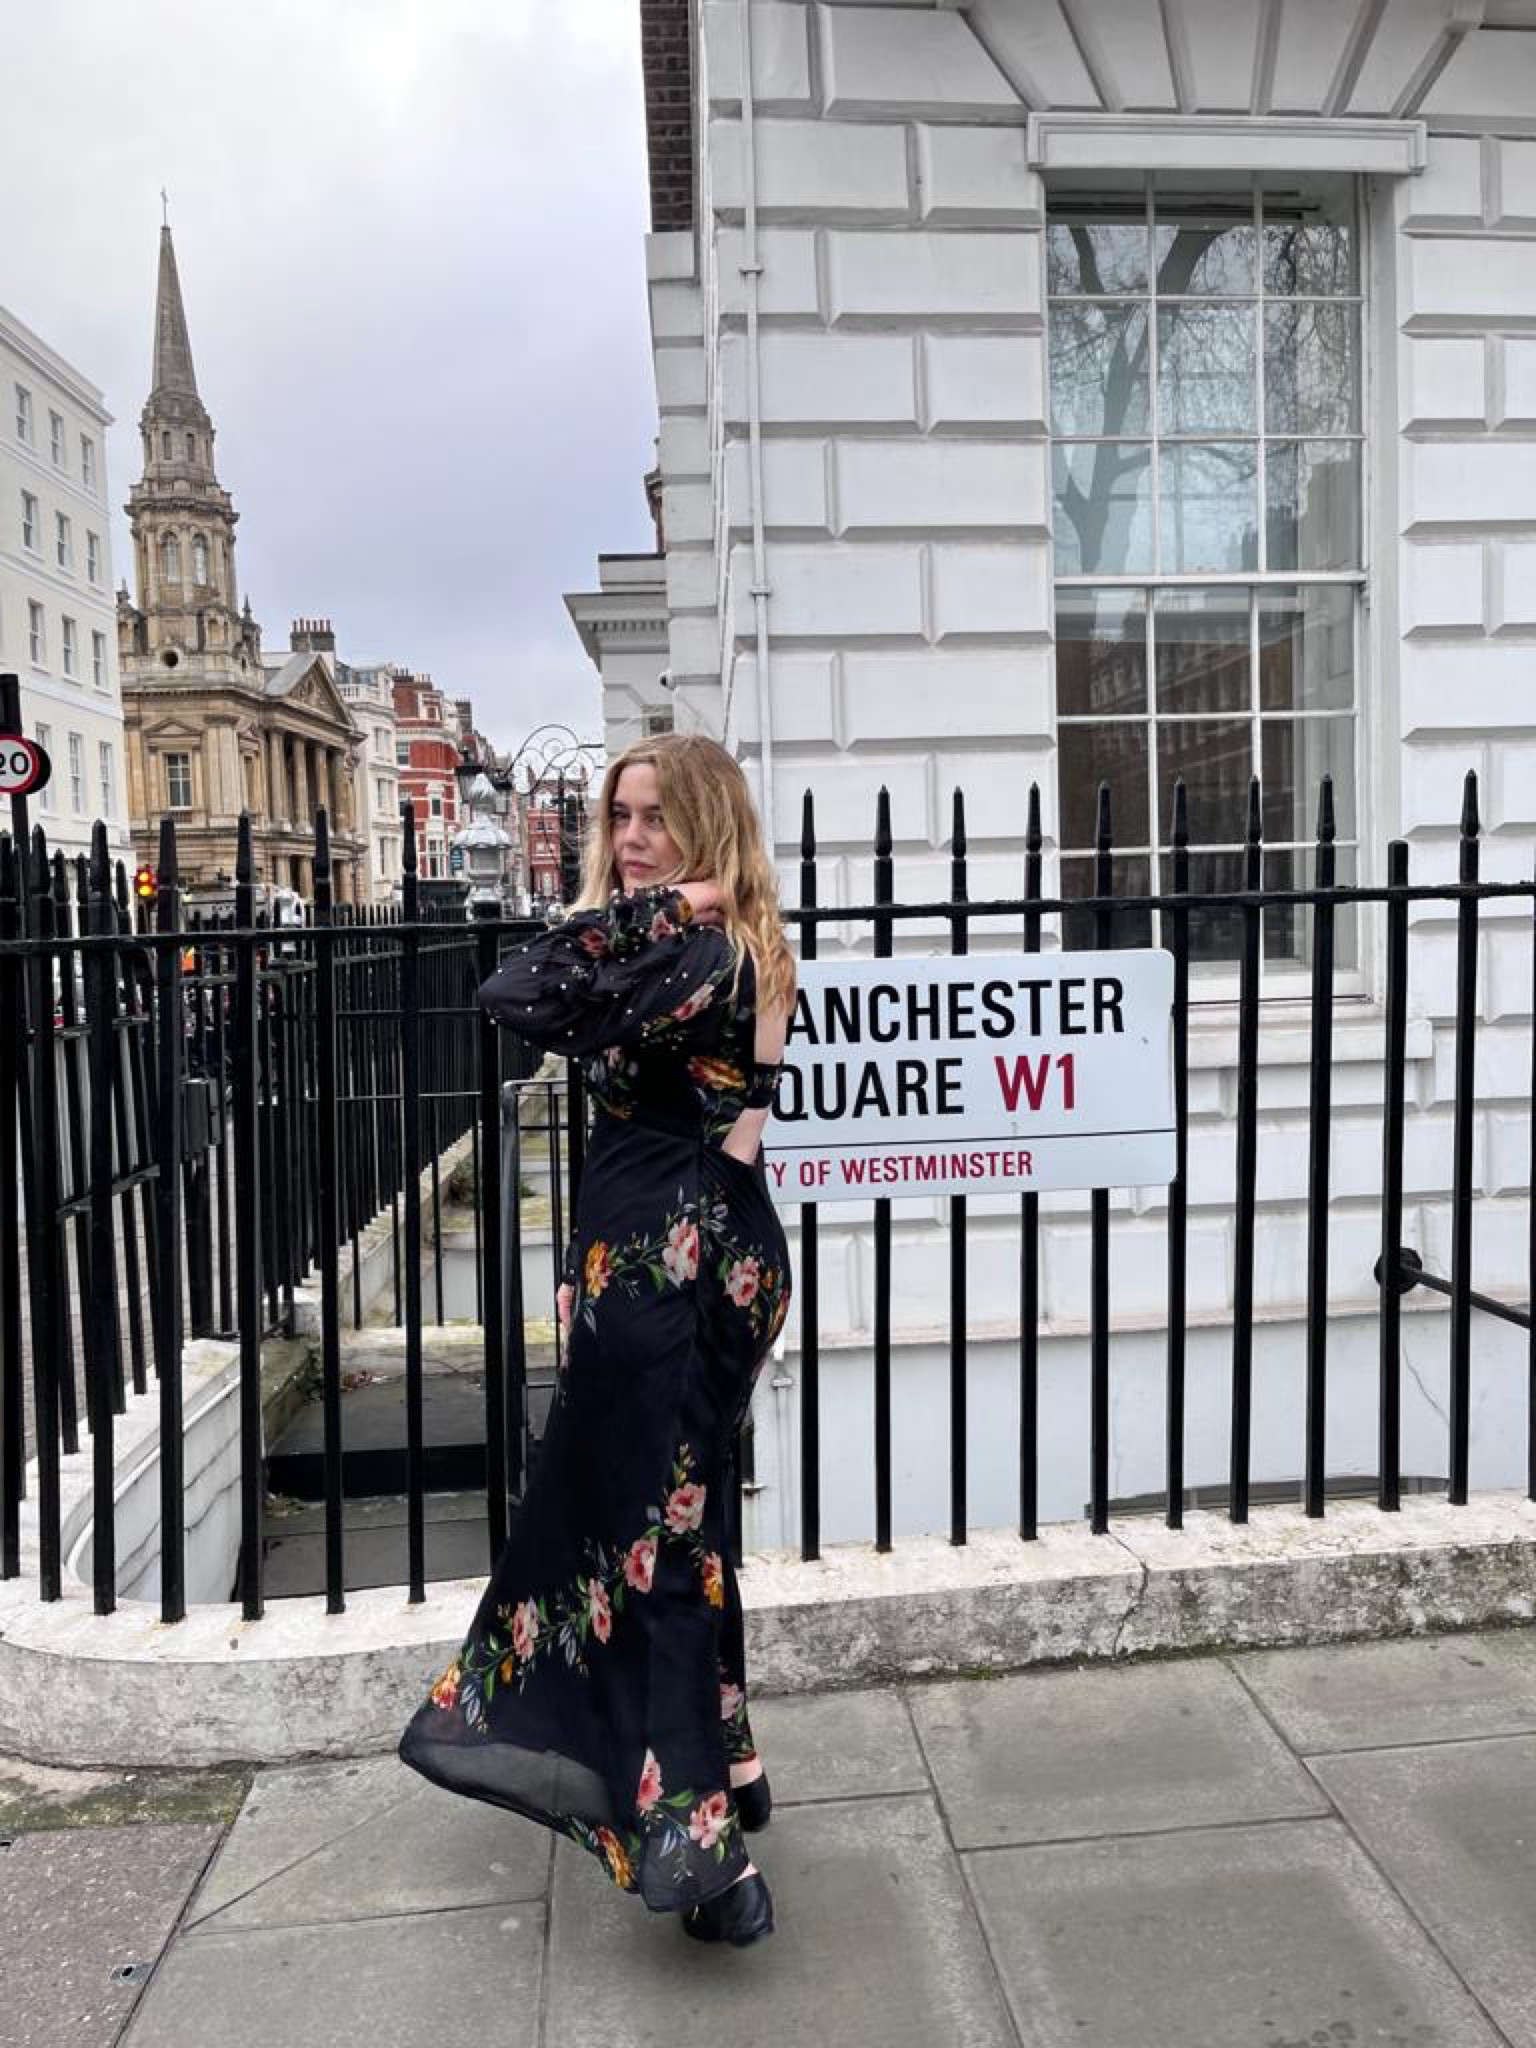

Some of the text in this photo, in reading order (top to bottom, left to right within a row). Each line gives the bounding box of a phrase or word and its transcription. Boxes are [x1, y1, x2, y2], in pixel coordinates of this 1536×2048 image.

[785, 977, 1125, 1046] ANCHESTER
[771, 1053, 1075, 1122] QUARE W1
[799, 1159, 831, 1187] OF
[841, 1152, 1032, 1184] WESTMINSTER
